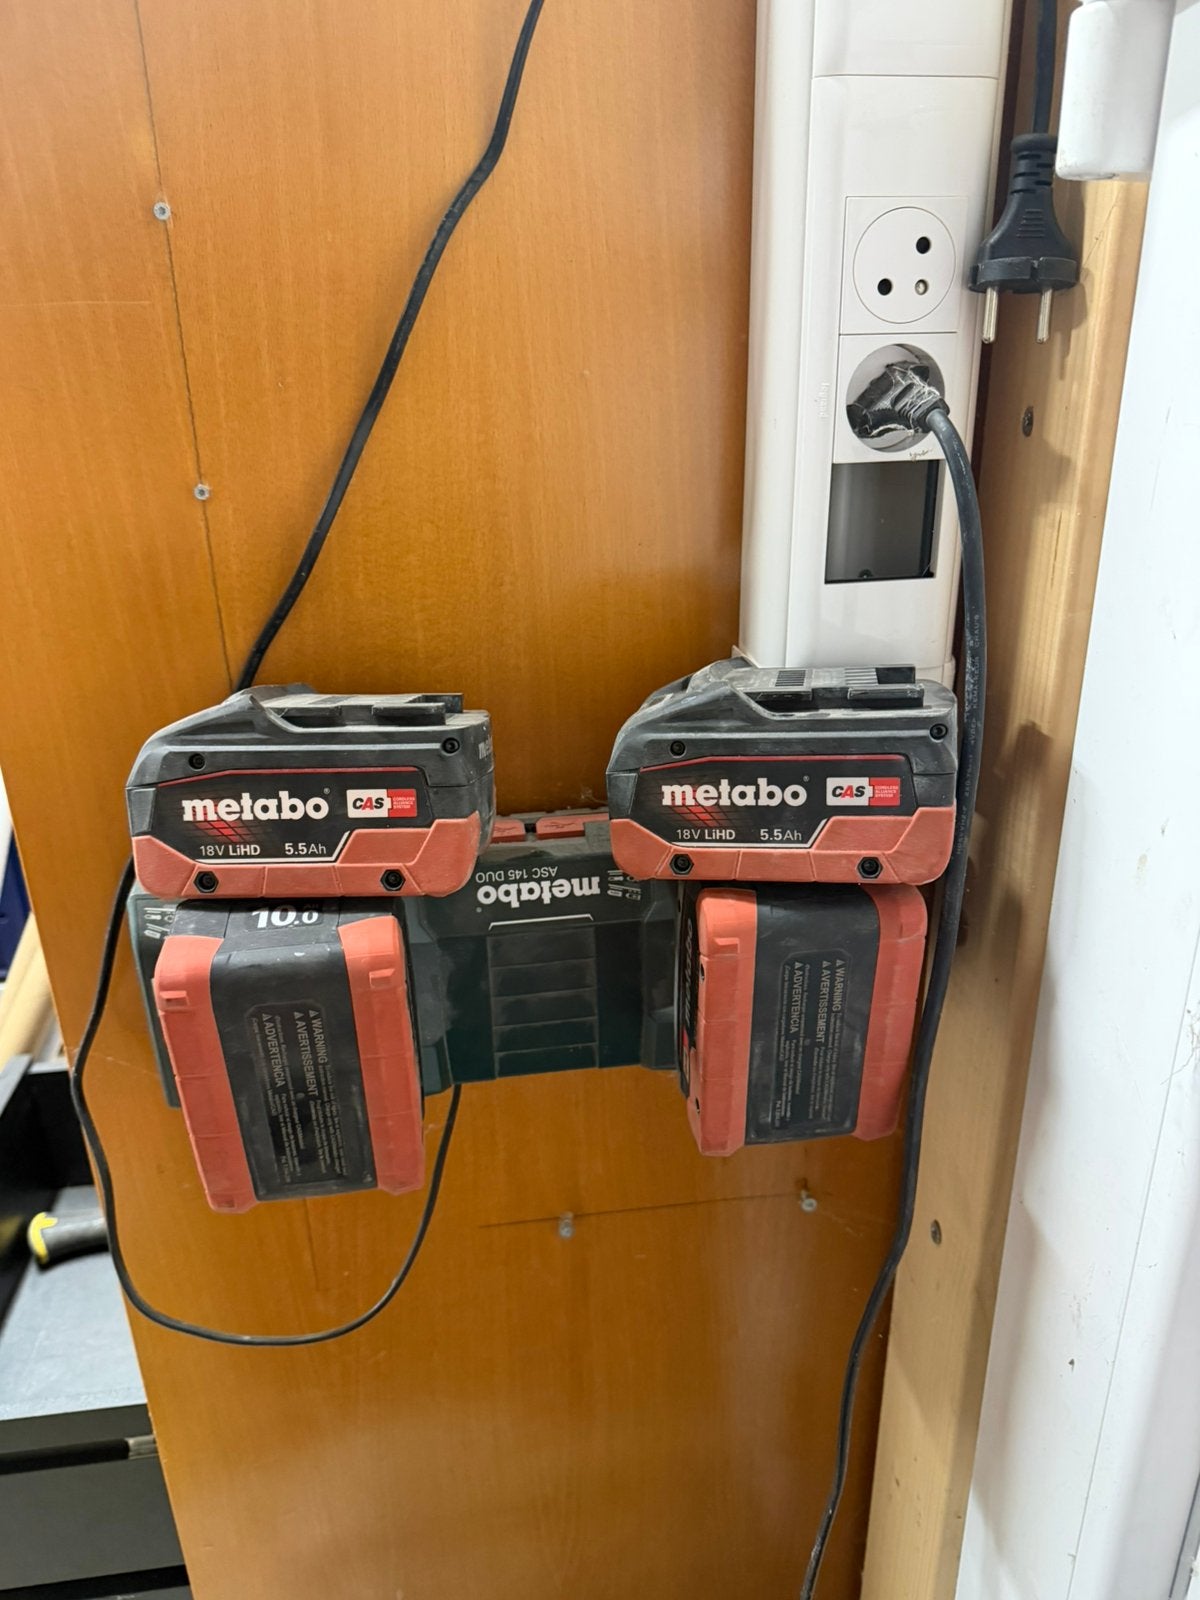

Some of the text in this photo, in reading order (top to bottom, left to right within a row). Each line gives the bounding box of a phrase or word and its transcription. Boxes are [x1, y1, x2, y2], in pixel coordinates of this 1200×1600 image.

[182, 791, 329, 822] metabo
[352, 797, 385, 811] CAS
[662, 778, 808, 806] metabo
[832, 785, 866, 798] CAS
[676, 829, 700, 840] 18V
[704, 828, 736, 840] LiHD
[200, 845, 225, 857] 18V
[228, 845, 261, 857] LiHD
[475, 866, 558, 883] ASC 145 DUO
[477, 876, 601, 909] metabo
[251, 905, 319, 929] 10.0
[789, 969, 802, 1034] ADVERTENCIA
[832, 967, 846, 1012] WARNING
[815, 968, 831, 1043] AVERTISSEMENT
[263, 1022, 285, 1087] ADVERTENCIA
[312, 1018, 328, 1064] WARNING
[295, 1022, 319, 1096] AVERTISSEMENT
